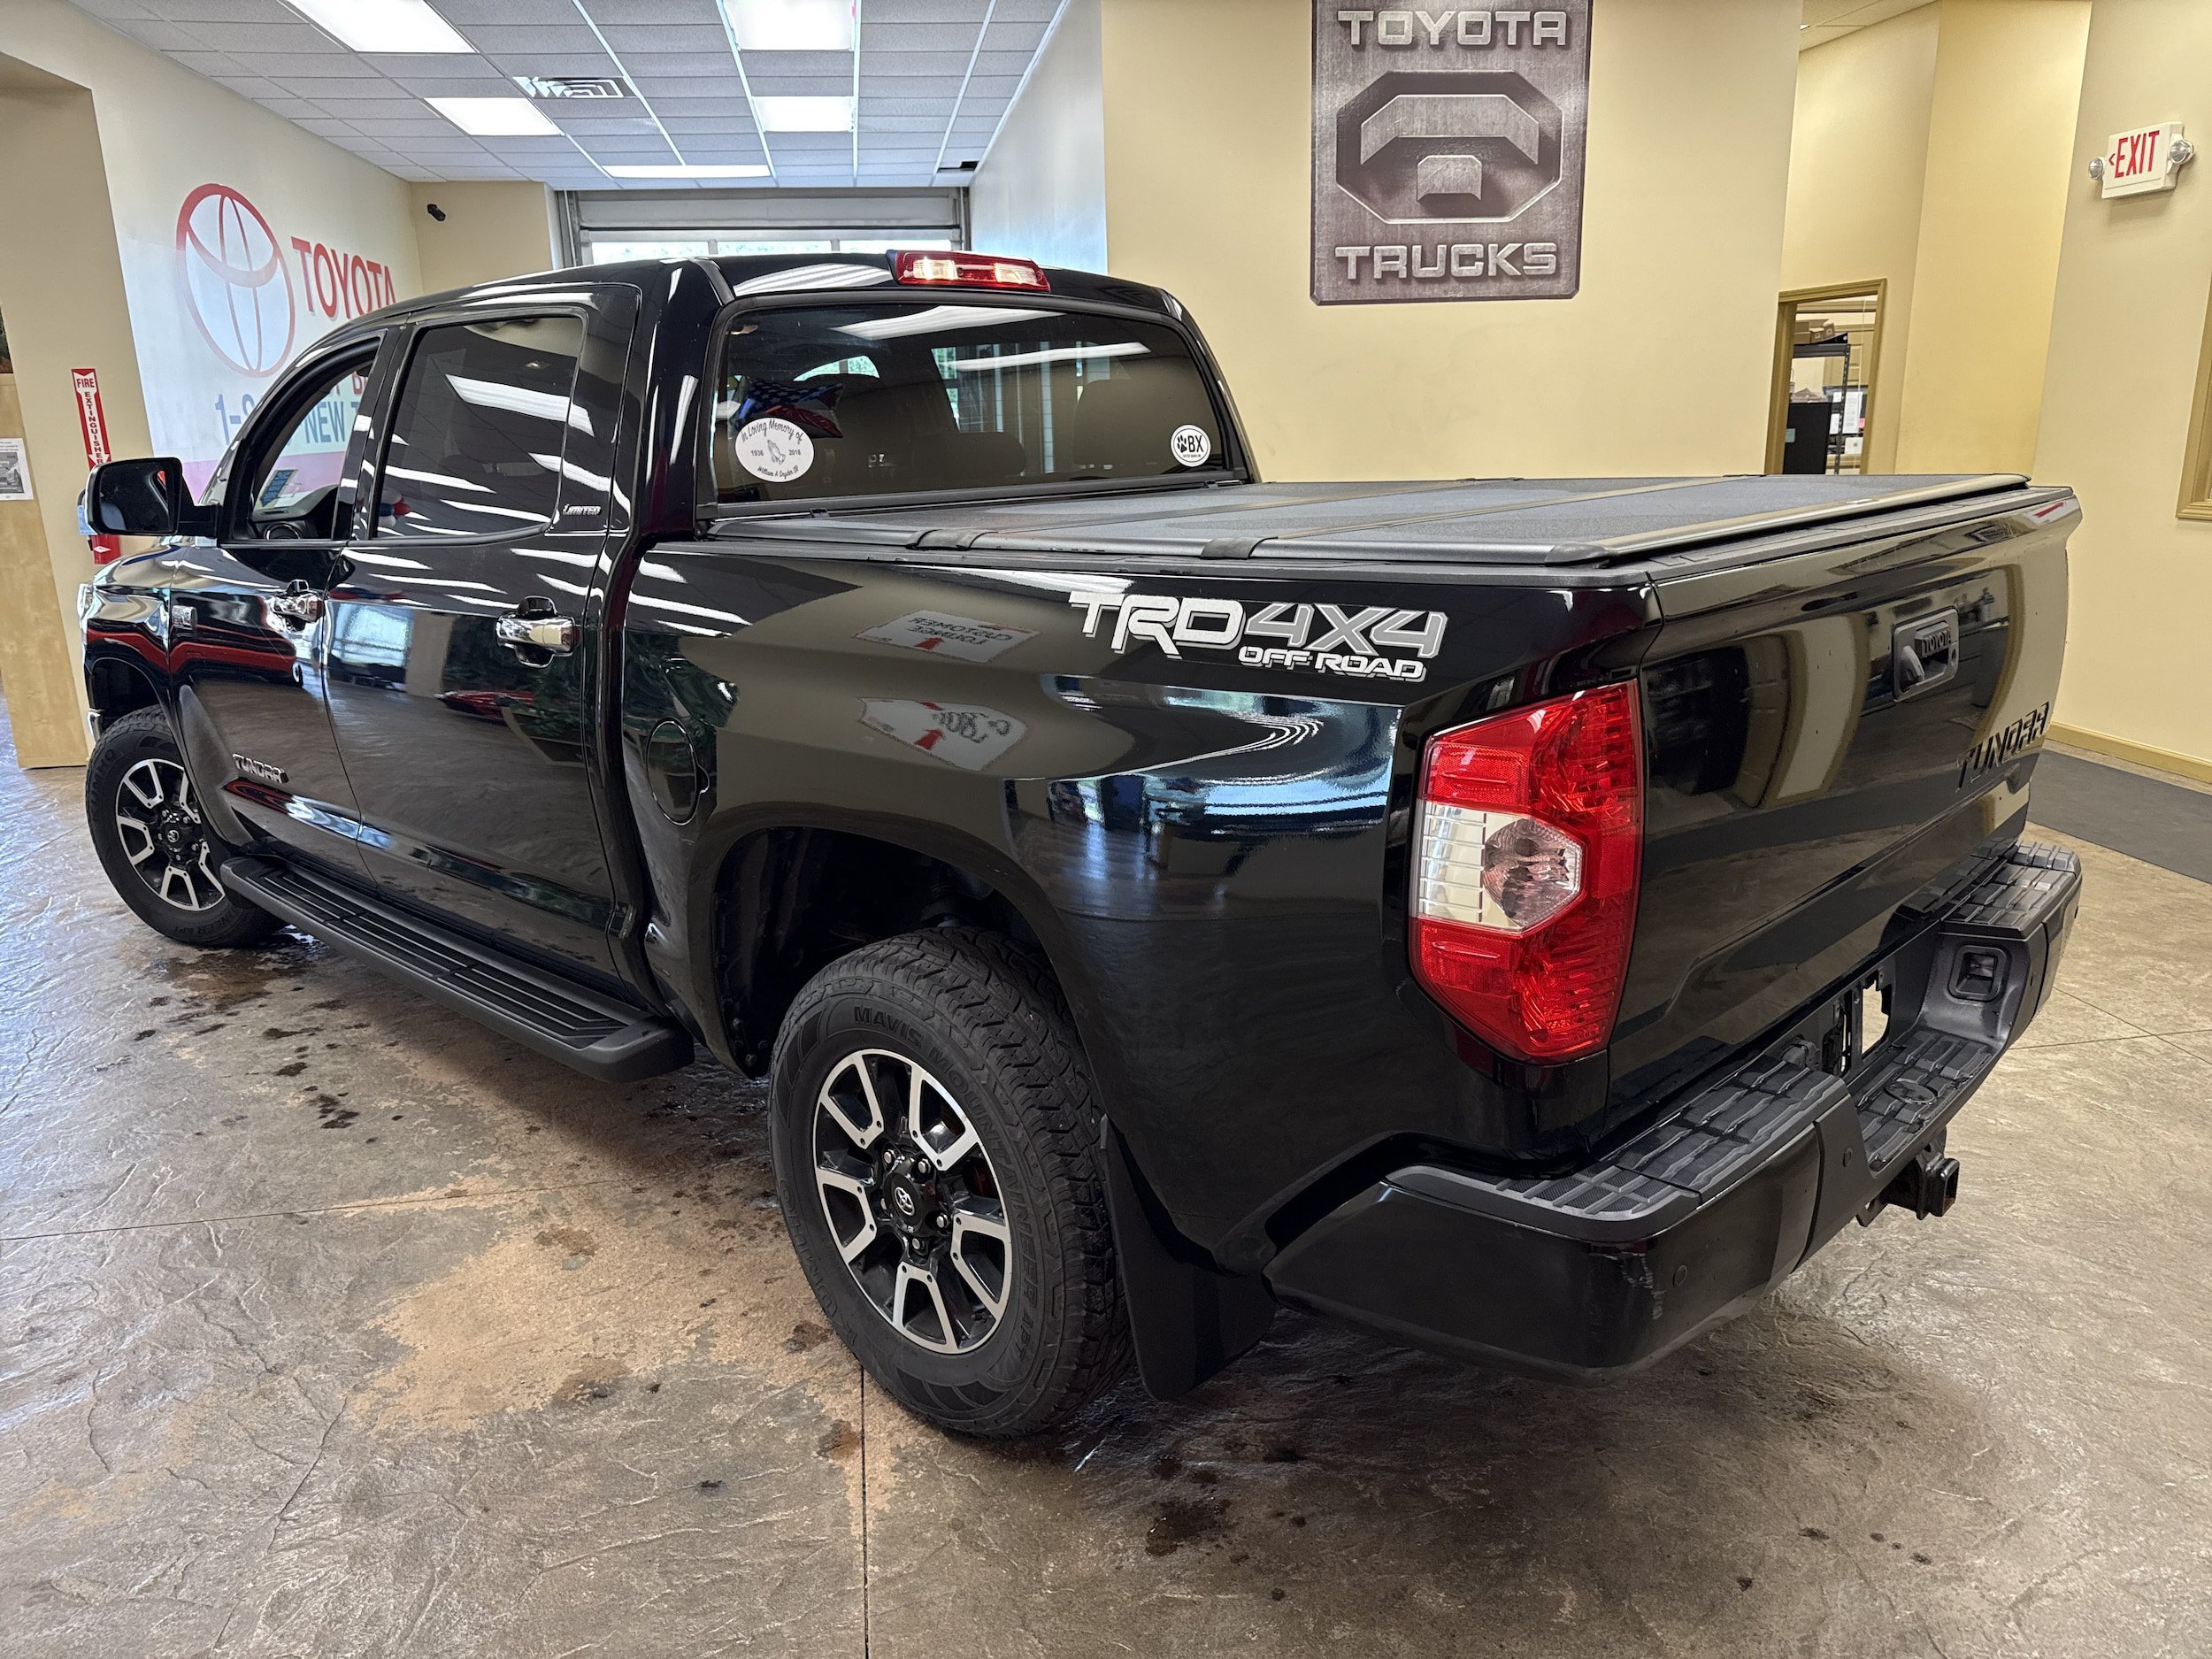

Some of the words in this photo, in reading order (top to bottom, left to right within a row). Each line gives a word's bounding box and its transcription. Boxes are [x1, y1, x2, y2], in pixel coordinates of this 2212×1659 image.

[1337, 10, 1567, 46] TOYOTA
[2115, 130, 2160, 179] EXIT
[291, 236, 396, 319] TOYOTA
[1335, 242, 1557, 280] TRUCKS
[76, 378, 95, 388] FIRE
[84, 392, 104, 465] EXTINGUISHER
[304, 401, 345, 443] NEW
[741, 430, 749, 442] In
[748, 422, 767, 437] Loving
[768, 419, 795, 441] Memory
[795, 432, 804, 445] of
[1187, 434, 1203, 452] BX
[1068, 590, 1246, 660] TRD
[1923, 627, 1952, 655] TOYOTA
[1238, 646, 1316, 671] OFF
[1314, 652, 1427, 683] ROAD
[1957, 702, 2049, 793] TUNDRA
[232, 753, 286, 784] TUNDRA
